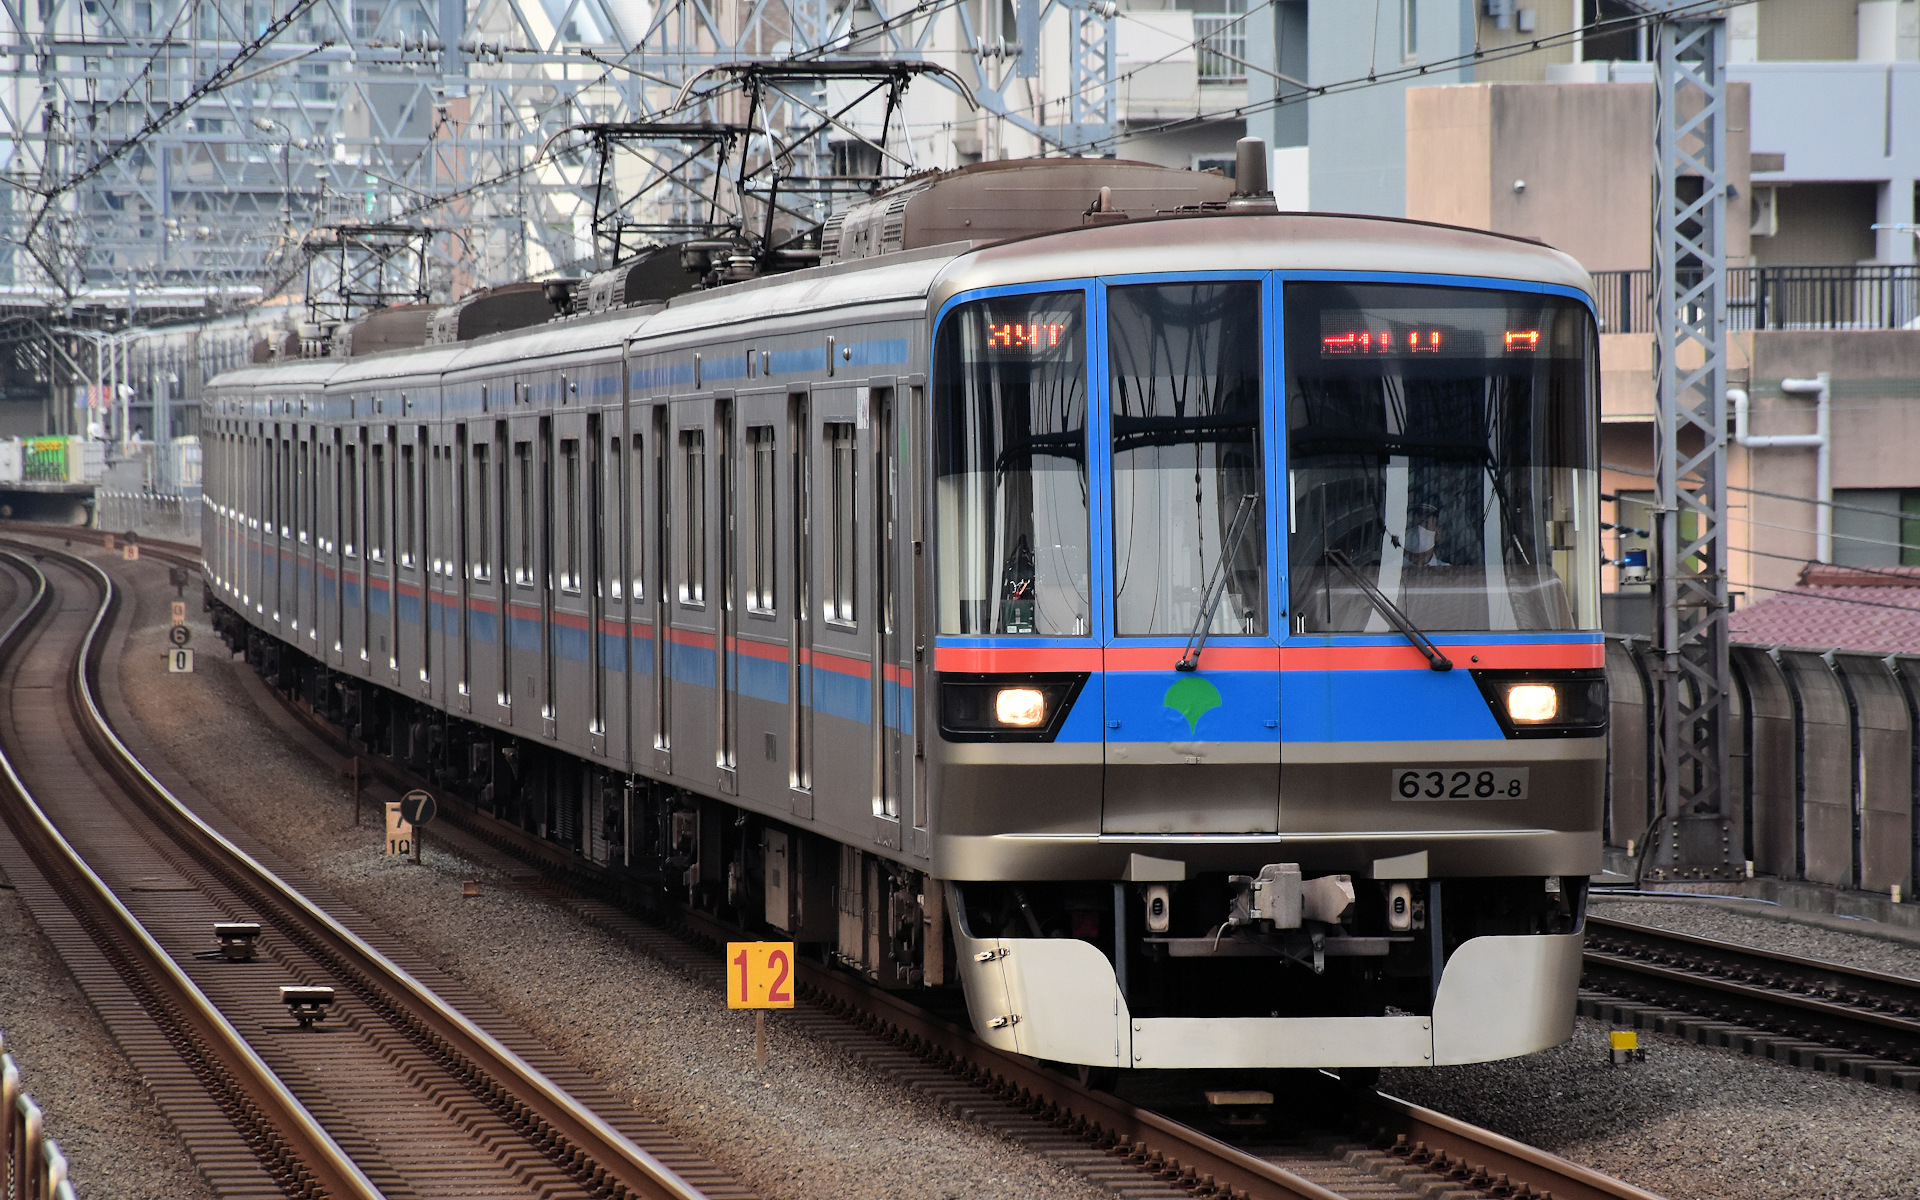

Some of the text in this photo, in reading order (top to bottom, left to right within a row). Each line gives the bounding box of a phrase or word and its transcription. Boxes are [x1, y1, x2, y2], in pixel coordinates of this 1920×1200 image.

[174, 627, 186, 643] 6
[177, 651, 186, 669] 0
[1399, 770, 1522, 798] 6328-8
[408, 795, 428, 821] 7
